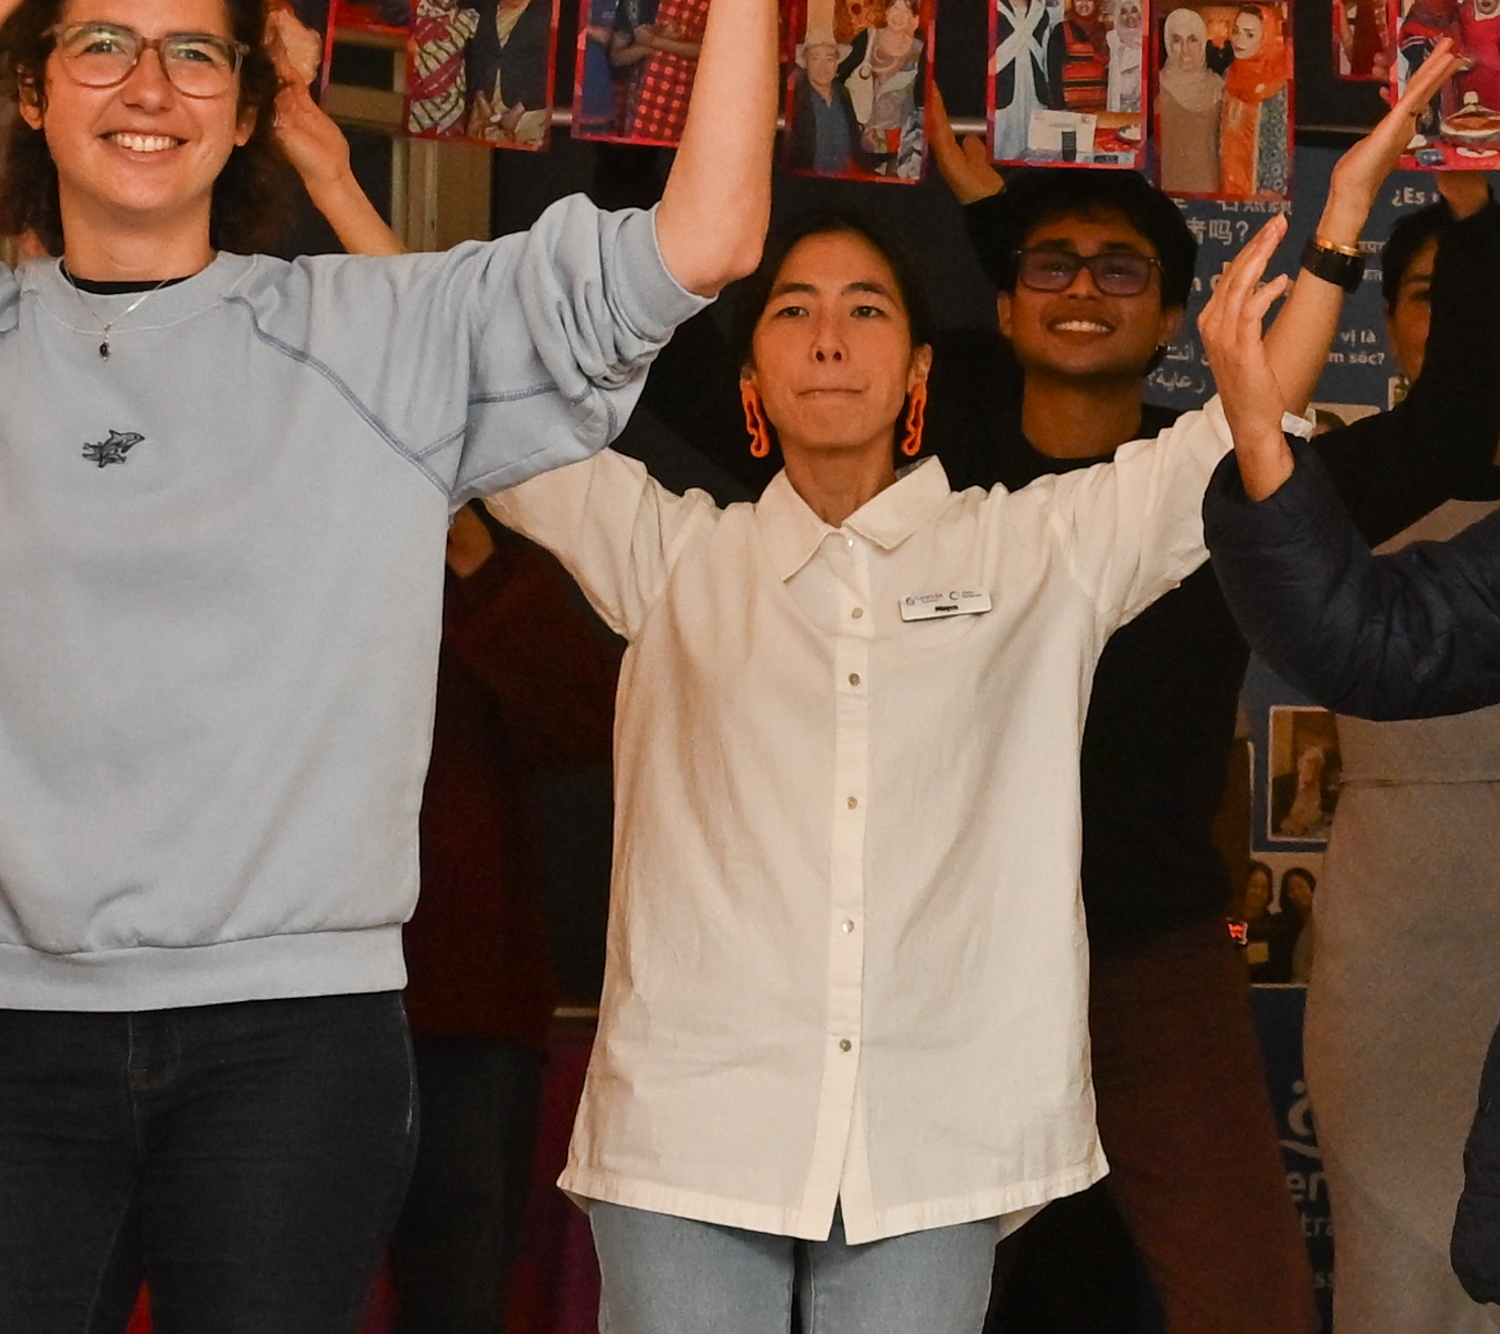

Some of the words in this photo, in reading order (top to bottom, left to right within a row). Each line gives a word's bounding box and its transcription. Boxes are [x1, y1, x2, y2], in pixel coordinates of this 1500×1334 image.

[1391, 186, 1426, 208] ¿Es
[1340, 330, 1356, 348] vị
[1360, 329, 1377, 344] là
[1349, 351, 1385, 366] sóc?
